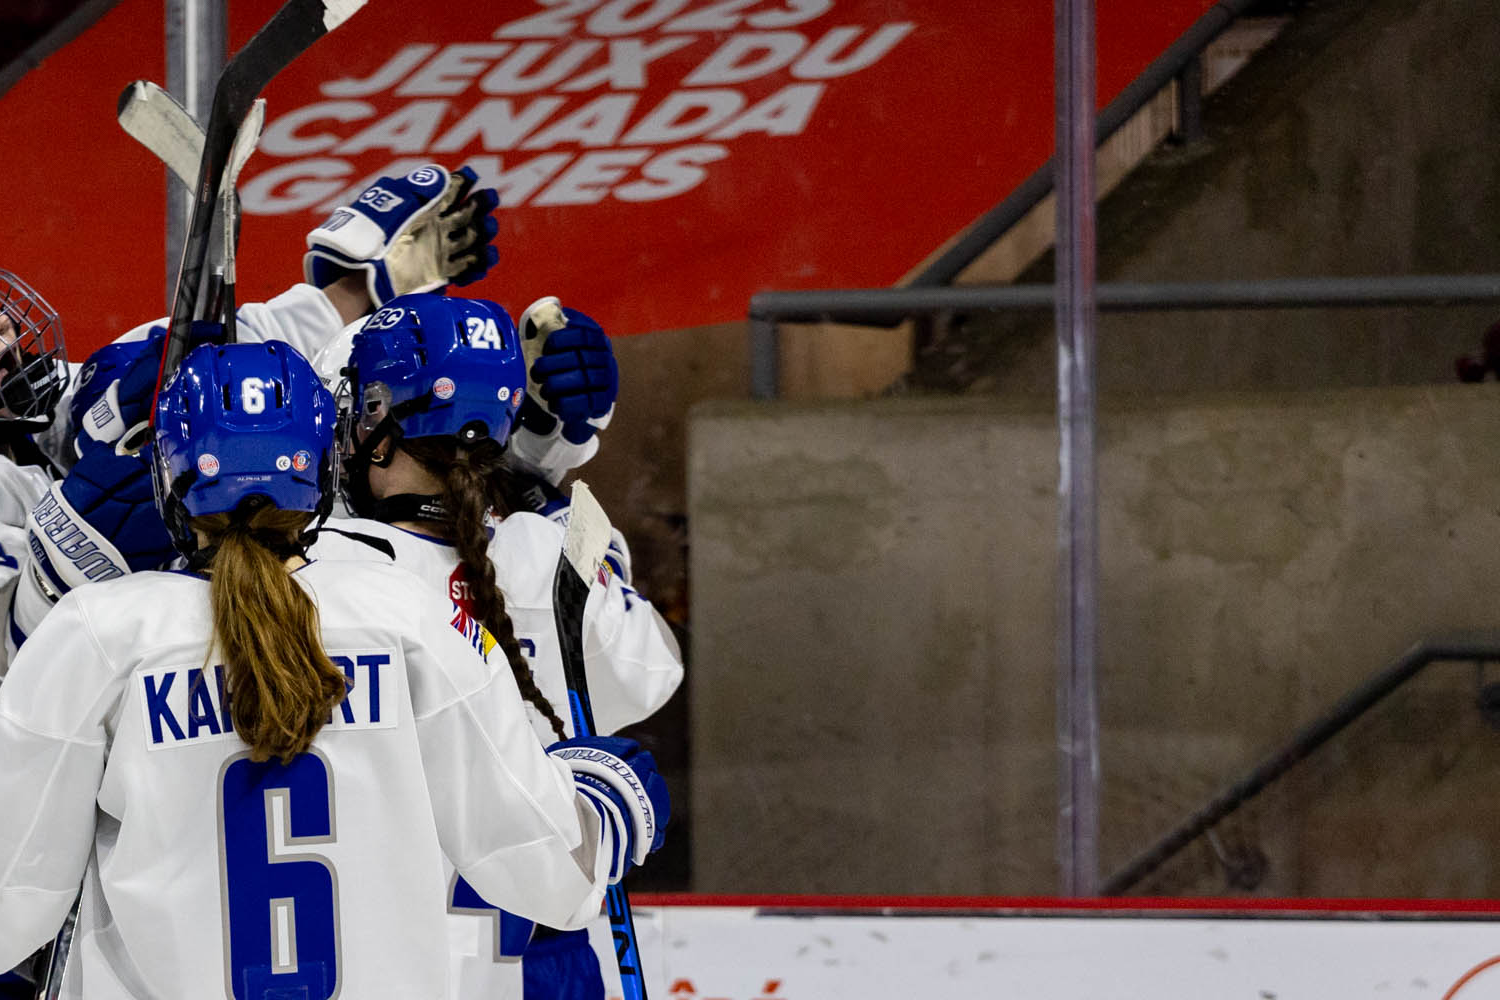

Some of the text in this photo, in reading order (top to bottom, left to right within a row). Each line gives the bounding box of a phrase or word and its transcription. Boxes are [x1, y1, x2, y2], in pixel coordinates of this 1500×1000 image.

[320, 23, 915, 97] JEUX DU
[257, 84, 828, 157] CANADA
[466, 316, 502, 351] 24
[241, 376, 266, 415] 6
